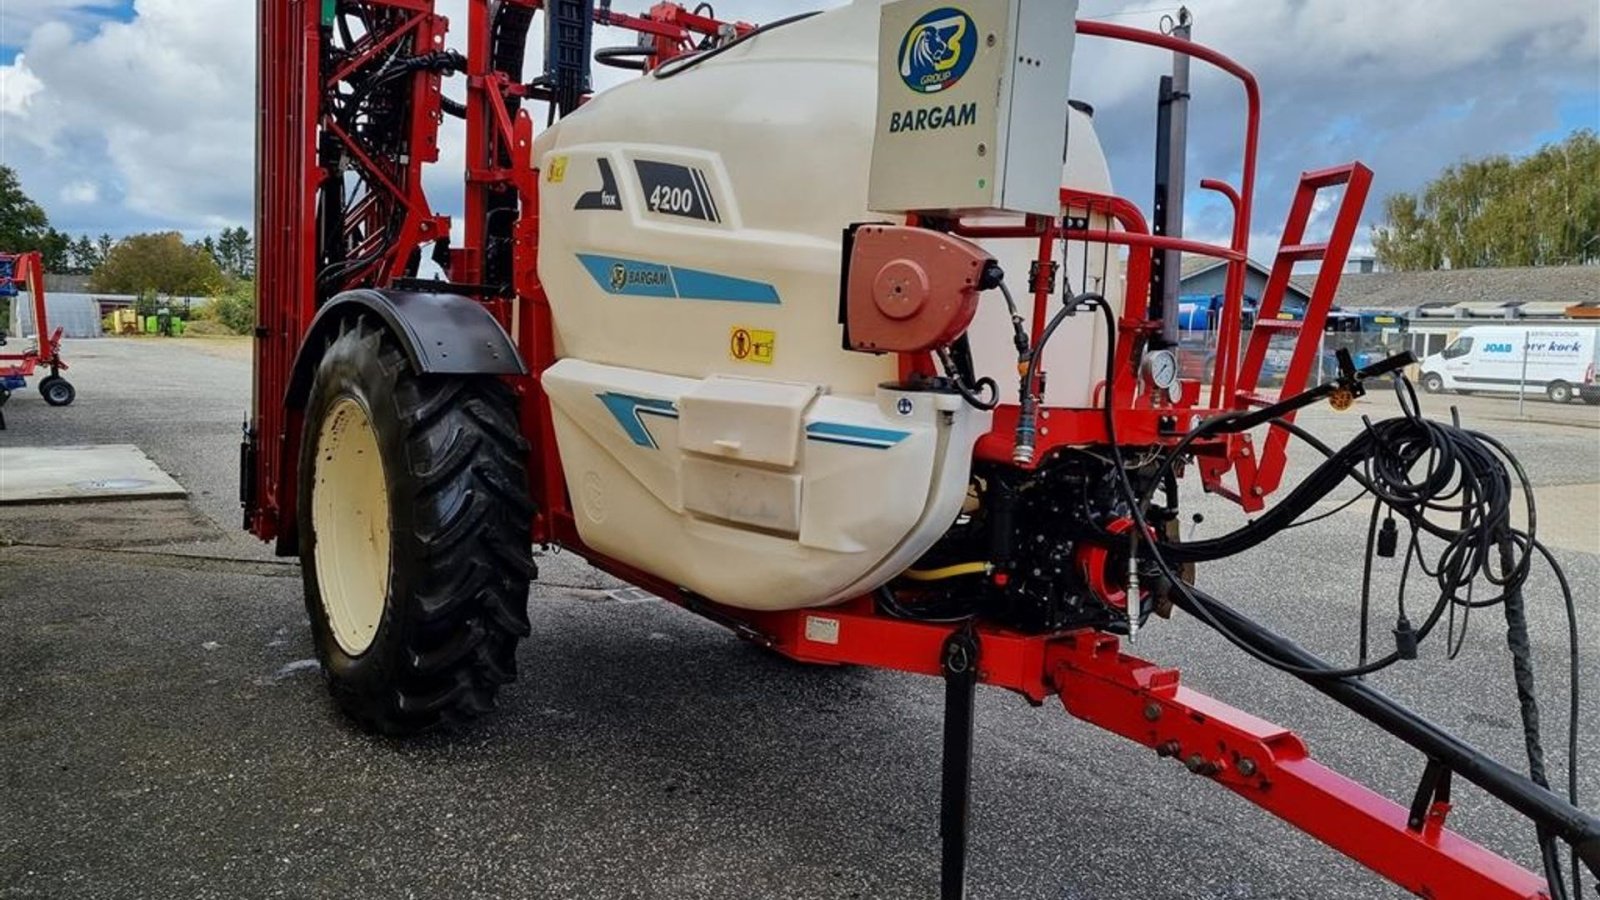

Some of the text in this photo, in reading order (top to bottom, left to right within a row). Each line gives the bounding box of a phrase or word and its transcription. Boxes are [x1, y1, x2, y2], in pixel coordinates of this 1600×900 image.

[920, 71, 951, 86] GROUP
[889, 103, 976, 132] BARGAM
[601, 190, 617, 206] fox
[650, 185, 692, 212] 4200
[628, 271, 668, 286] BARGAM
[1483, 343, 1512, 353] JOAB
